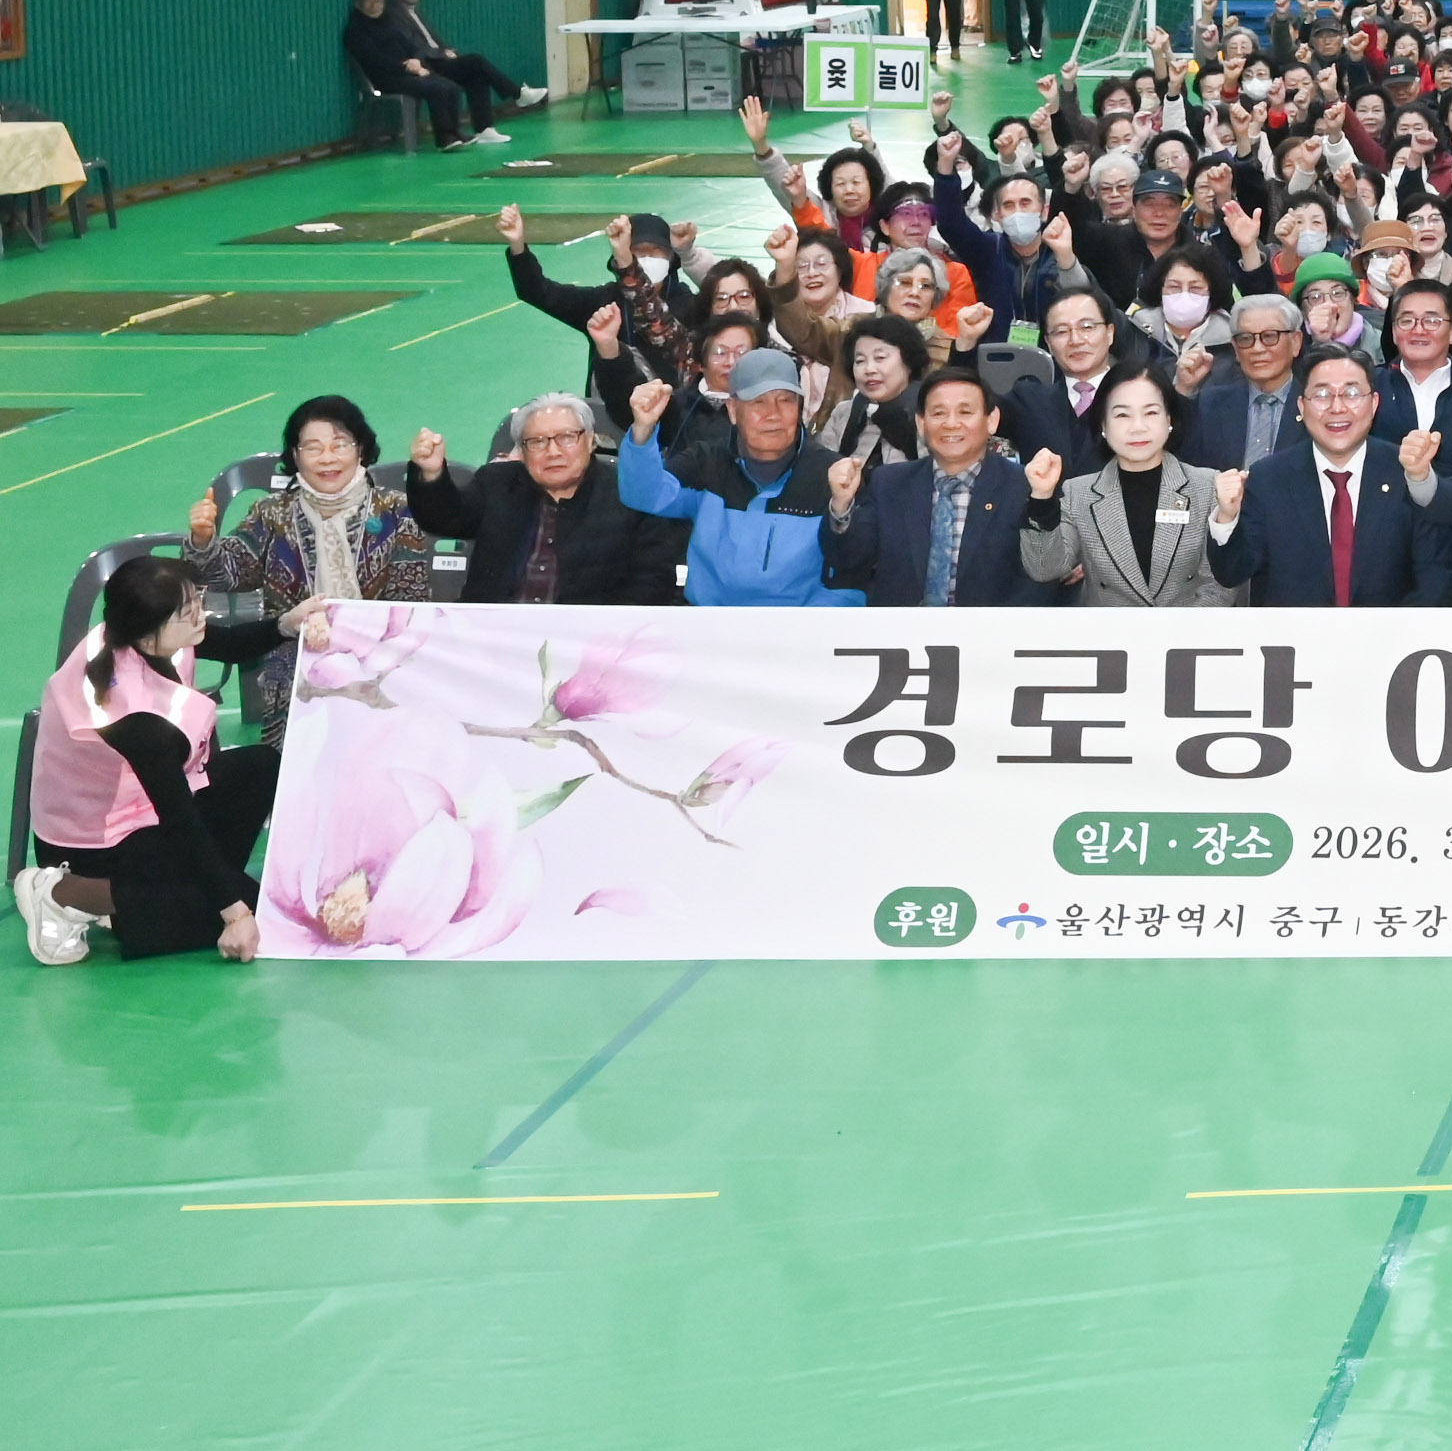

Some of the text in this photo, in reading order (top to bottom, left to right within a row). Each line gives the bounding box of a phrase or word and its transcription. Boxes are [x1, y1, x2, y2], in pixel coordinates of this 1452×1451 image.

[878, 60, 920, 91] 놀이
[824, 644, 1313, 779] 경로당
[1076, 821, 1274, 866] 일시 장소
[1311, 825, 1418, 864] 2026.
[888, 901, 958, 937] 후원
[1055, 903, 1245, 938] 울산광역시
[1269, 905, 1343, 938] 중구
